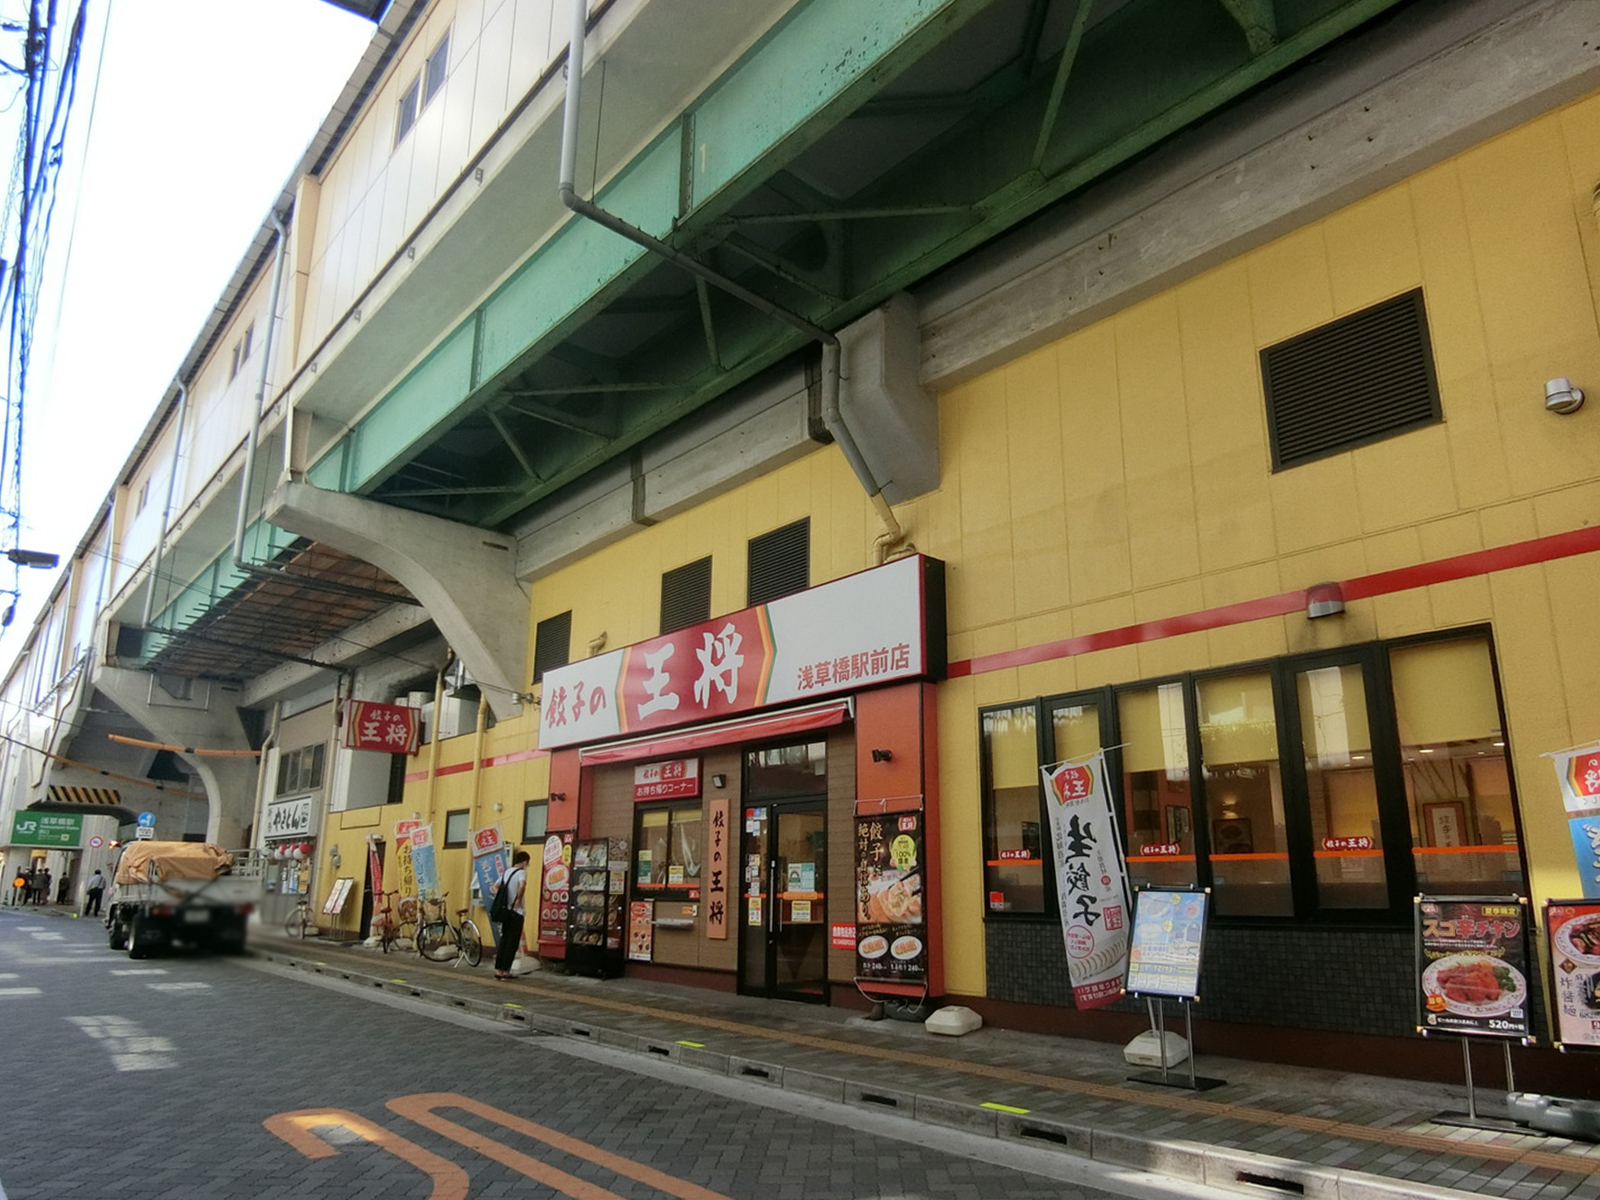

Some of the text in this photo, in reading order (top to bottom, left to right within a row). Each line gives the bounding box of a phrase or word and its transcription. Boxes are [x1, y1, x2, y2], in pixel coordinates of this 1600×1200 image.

[545, 622, 744, 728] 餃子の 王将
[797, 643, 910, 691] 浅草橋駅前店
[361, 721, 407, 746] 王将
[637, 782, 693, 796] お持ち帰りコーナー
[16, 821, 37, 831] JR
[870, 821, 883, 876] 餃子に
[709, 810, 724, 925] 餃子の王将
